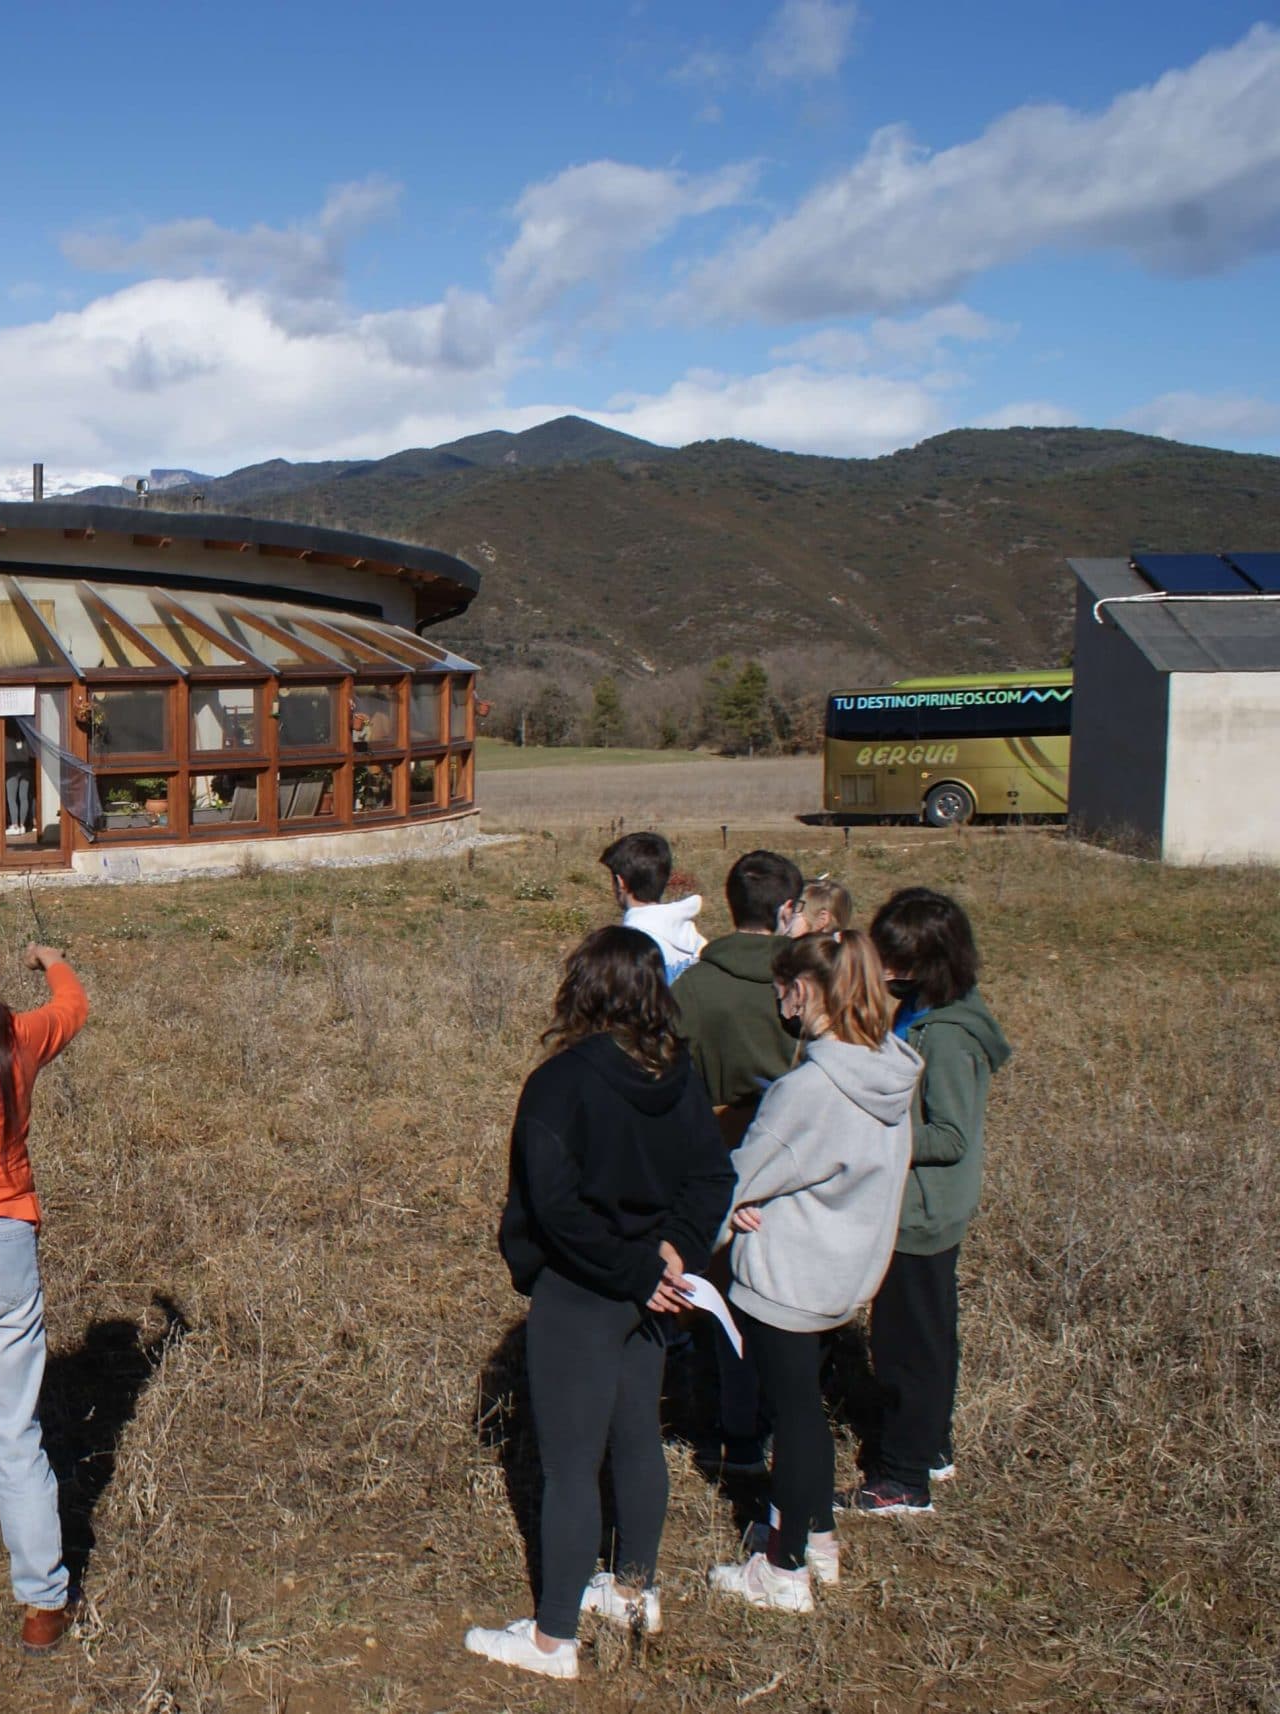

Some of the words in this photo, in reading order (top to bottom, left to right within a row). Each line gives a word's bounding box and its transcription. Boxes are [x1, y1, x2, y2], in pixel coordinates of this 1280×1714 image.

[834, 697, 854, 710] TU
[856, 690, 1022, 709] DESTINOPIRINEOS.COM
[856, 744, 959, 766] BERGUA
